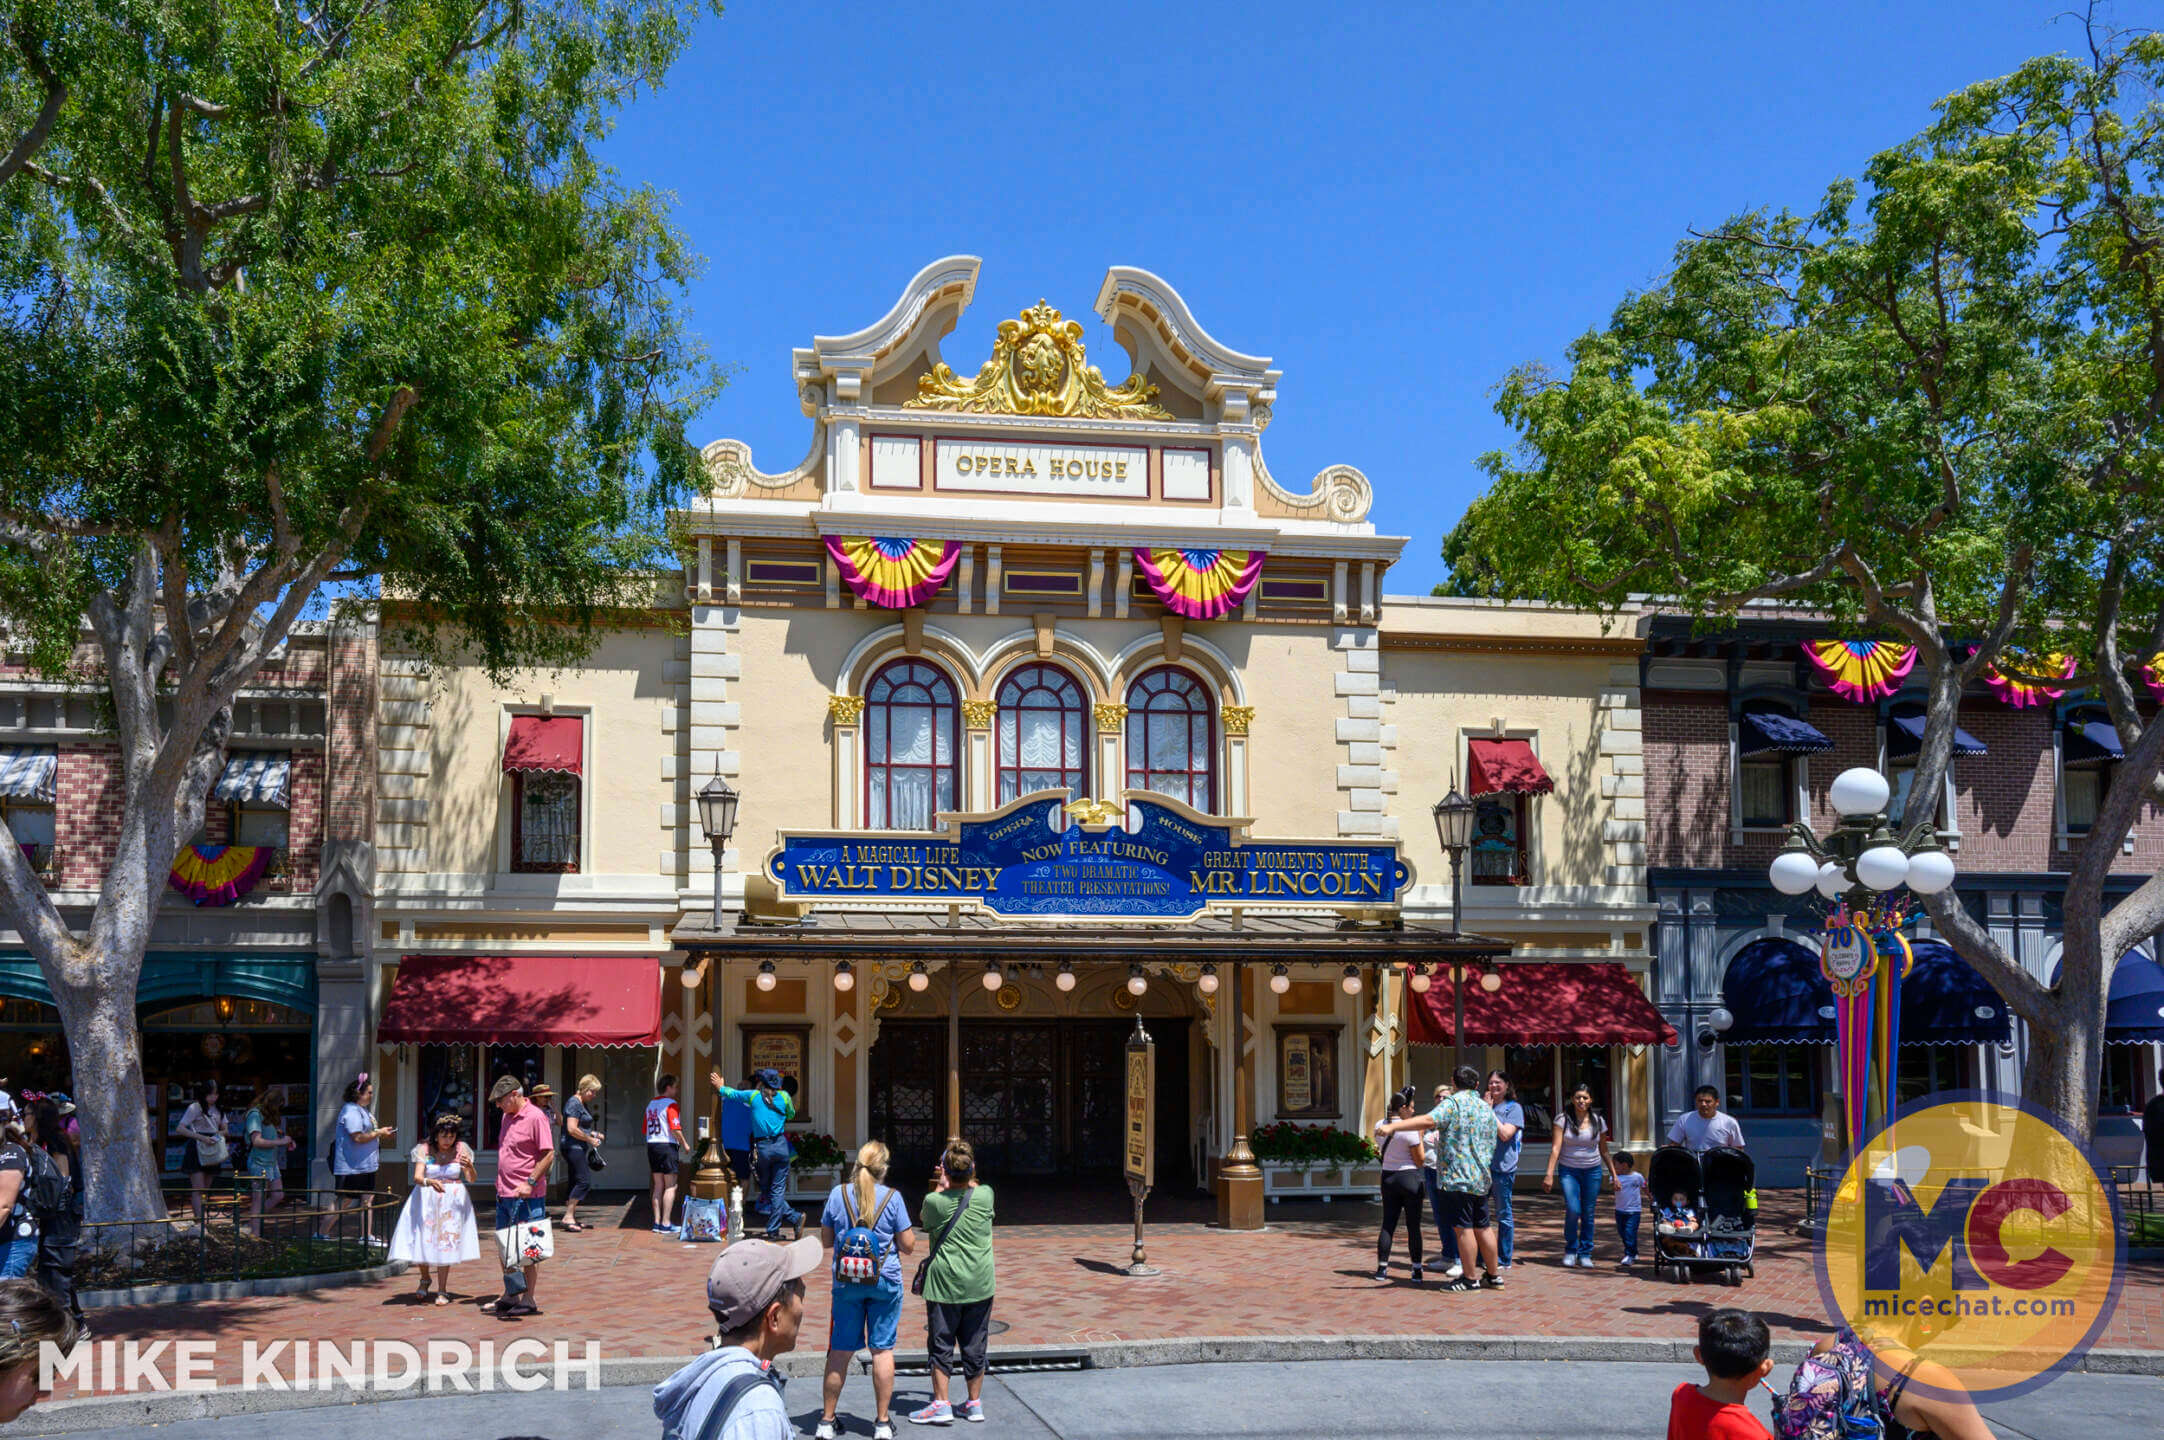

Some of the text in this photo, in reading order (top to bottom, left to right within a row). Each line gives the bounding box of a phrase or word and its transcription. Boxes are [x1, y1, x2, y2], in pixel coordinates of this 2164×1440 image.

[956, 455, 1128, 480] OPERA HOUSE
[988, 815, 1204, 845] OPERA HOUSE
[840, 845, 959, 865] A MAGICAL LIFE
[1021, 840, 1169, 866] NOW FEATURING
[1203, 851, 1369, 871] GREAT MOMENTS WITH
[796, 865, 1003, 892] WALT DISNEY
[1052, 864, 1140, 880] TWO DRAMATIC
[1189, 870, 1383, 896] MR. LINCOLN
[1021, 880, 1170, 896] THEATER PRESENTATIONS!
[1828, 927, 1852, 949] 70
